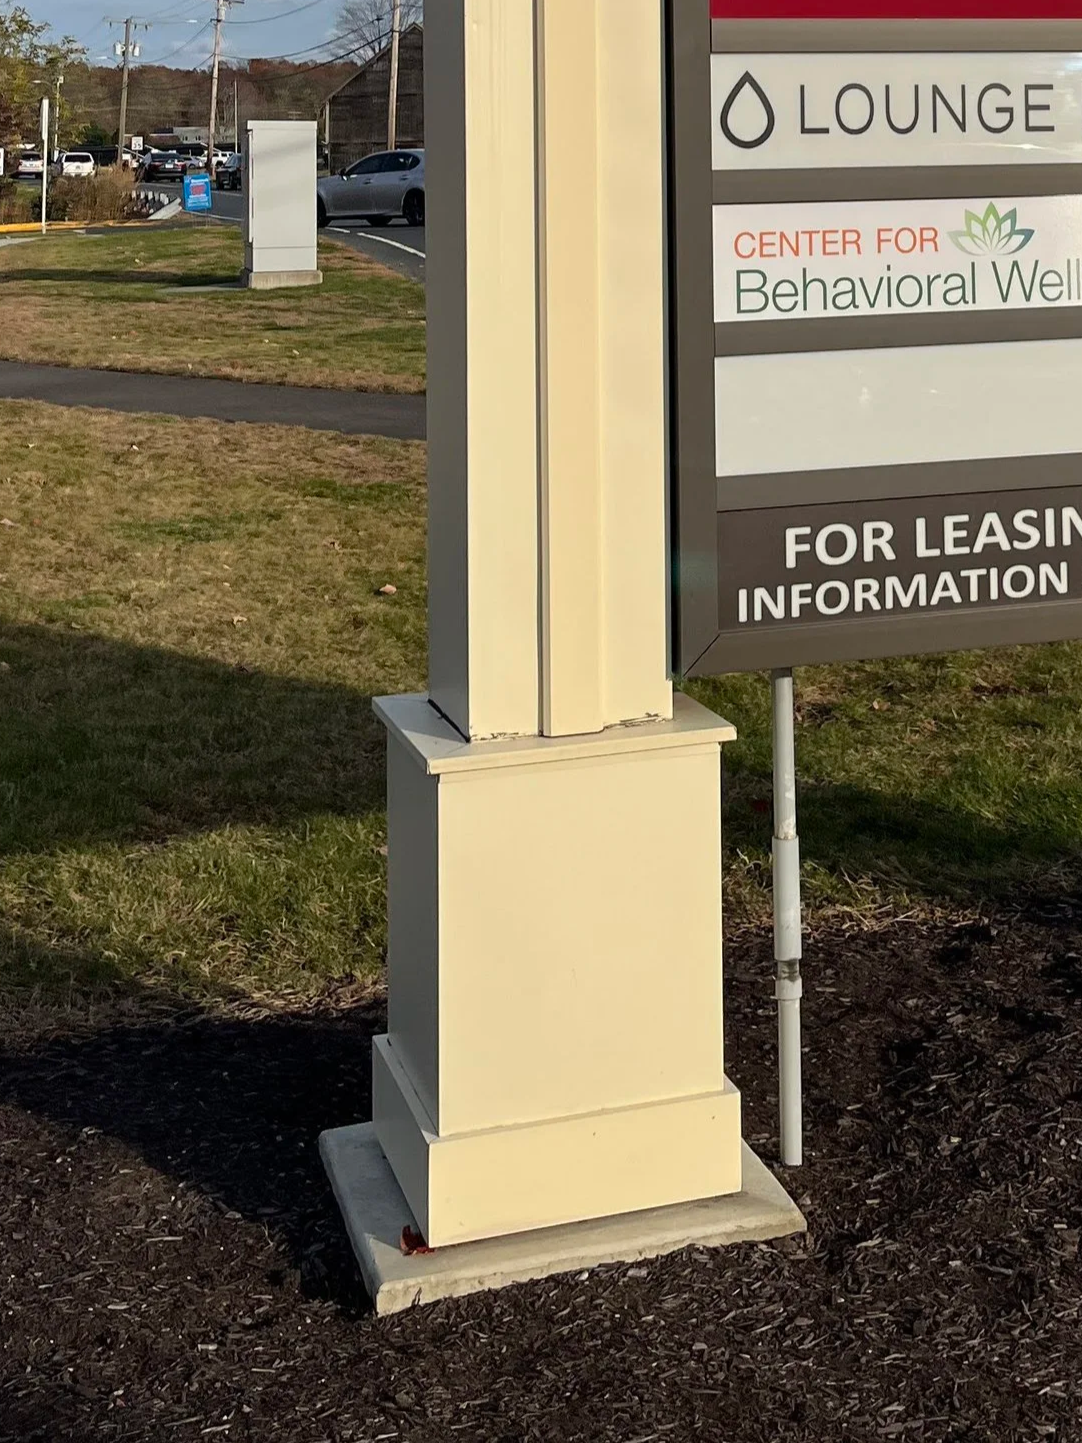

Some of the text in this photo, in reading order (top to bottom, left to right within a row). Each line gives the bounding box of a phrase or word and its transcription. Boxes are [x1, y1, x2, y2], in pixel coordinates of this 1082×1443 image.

[800, 83, 1055, 135] LOUNGE
[733, 226, 939, 259] CENTER FOR
[735, 261, 976, 314] Behavioral
[784, 520, 896, 569] FOR
[737, 561, 1069, 623] INFORMATION
